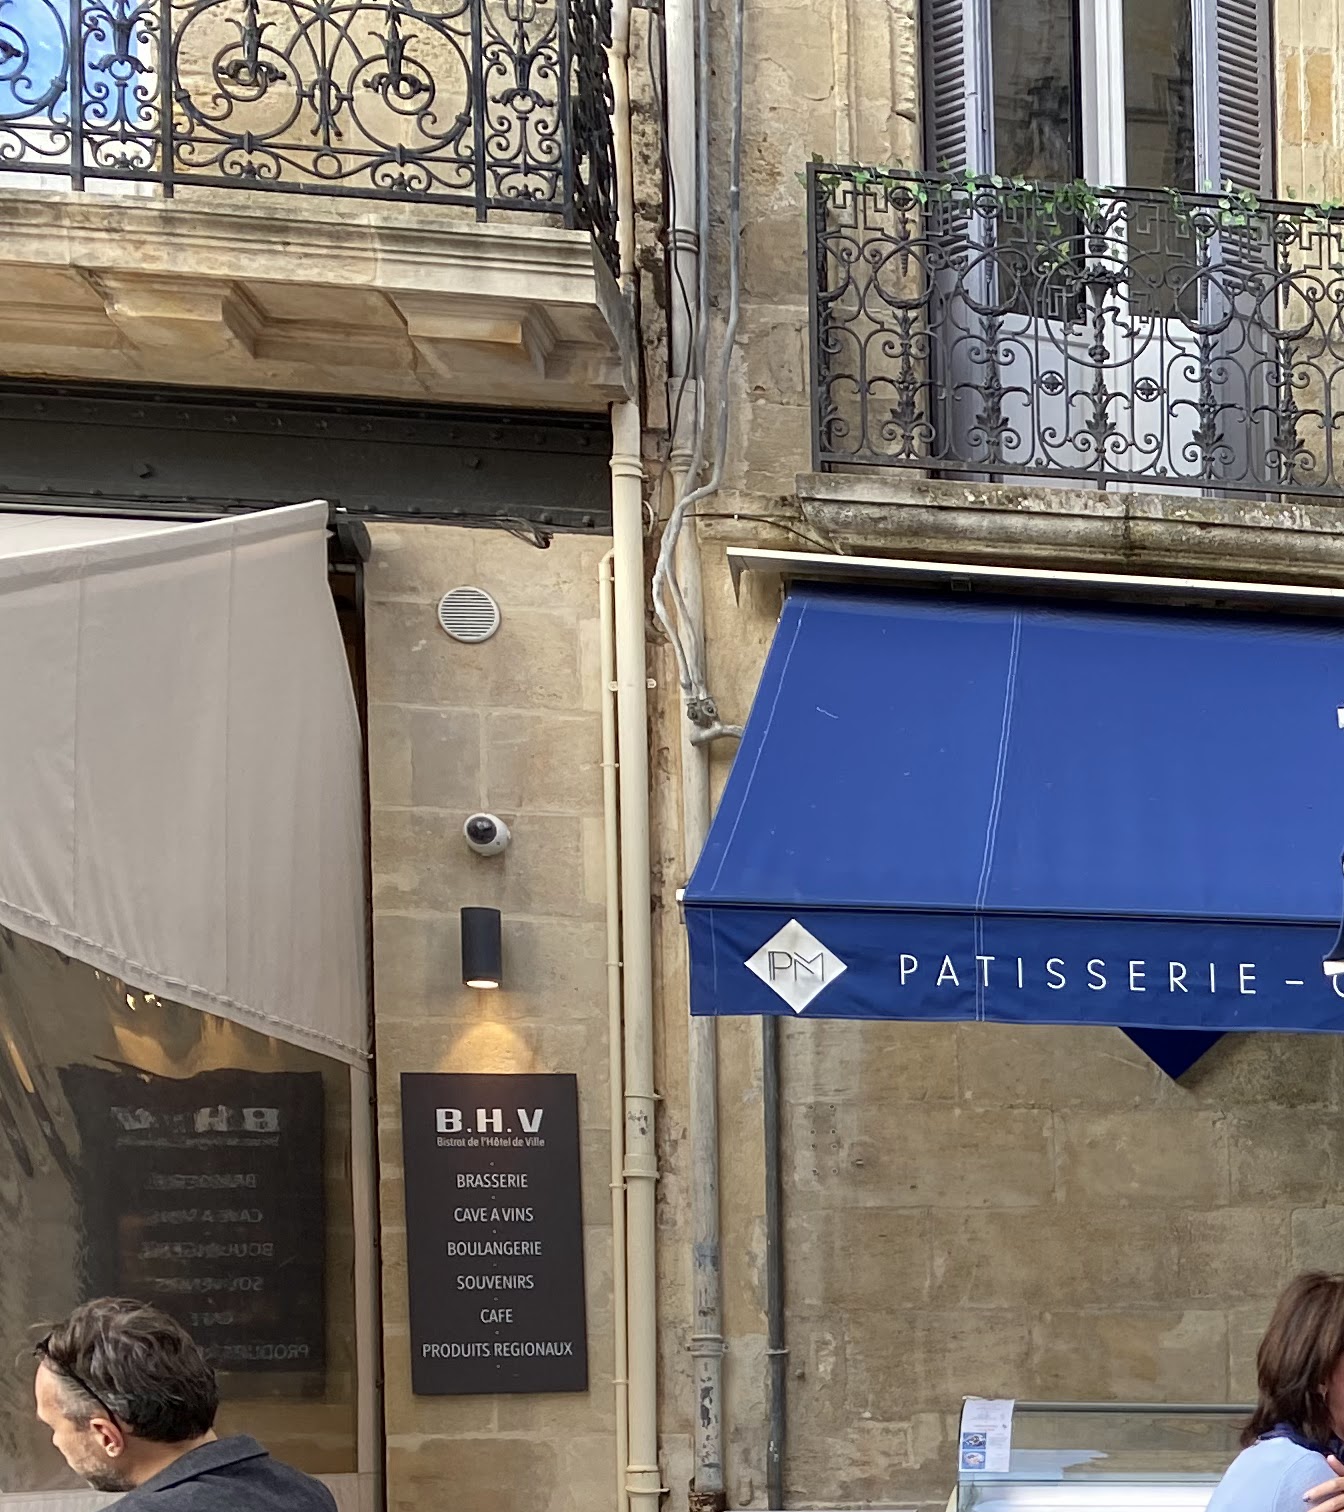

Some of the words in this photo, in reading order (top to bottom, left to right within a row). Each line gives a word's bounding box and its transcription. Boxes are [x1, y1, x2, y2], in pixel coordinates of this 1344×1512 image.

[768, 950, 826, 984] PM
[899, 953, 1257, 996] PATISSERIE
[435, 1107, 544, 1133] B.H.V
[436, 1136, 466, 1148] Bistrot
[467, 1137, 479, 1147] de
[512, 1136, 524, 1147] de
[524, 1136, 545, 1147] Ville
[456, 1173, 529, 1189] BRASSERIE
[453, 1207, 488, 1223] CAVE
[490, 1207, 500, 1222] A
[501, 1206, 534, 1222] VINS
[447, 1240, 542, 1257] BOULANGERIE
[456, 1274, 535, 1290] SOUVENIRS
[480, 1308, 514, 1324] CAFE
[422, 1342, 491, 1358] PRODUITS
[493, 1341, 573, 1357] REGIONAUX
